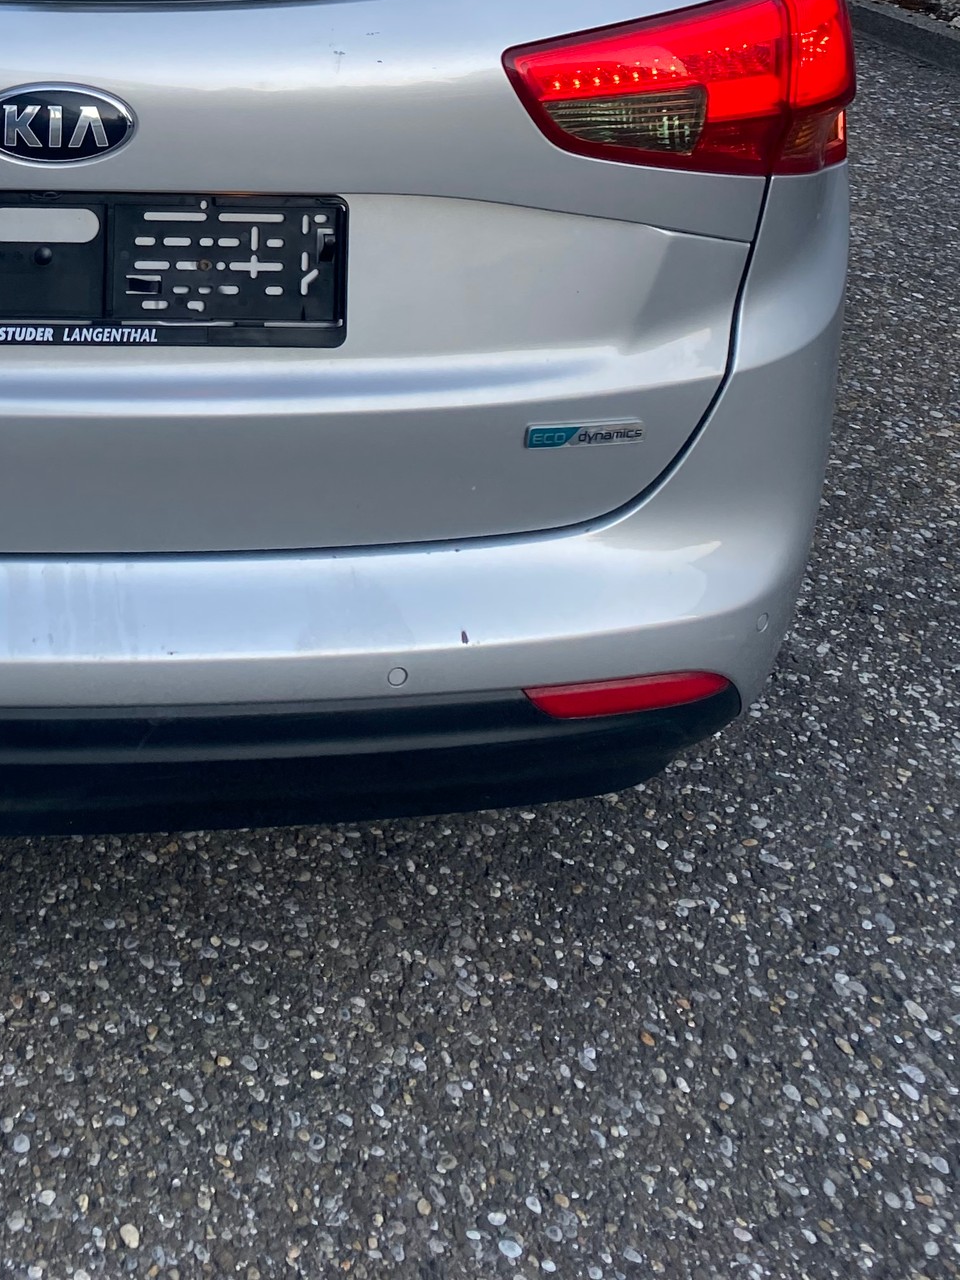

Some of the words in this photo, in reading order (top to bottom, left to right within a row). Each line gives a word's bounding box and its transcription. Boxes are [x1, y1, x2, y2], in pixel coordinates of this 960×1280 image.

[2, 104, 110, 148] KIA
[62, 327, 158, 343] LANGENTHAL
[532, 432, 566, 444] ECO
[577, 428, 643, 444] dynamics
